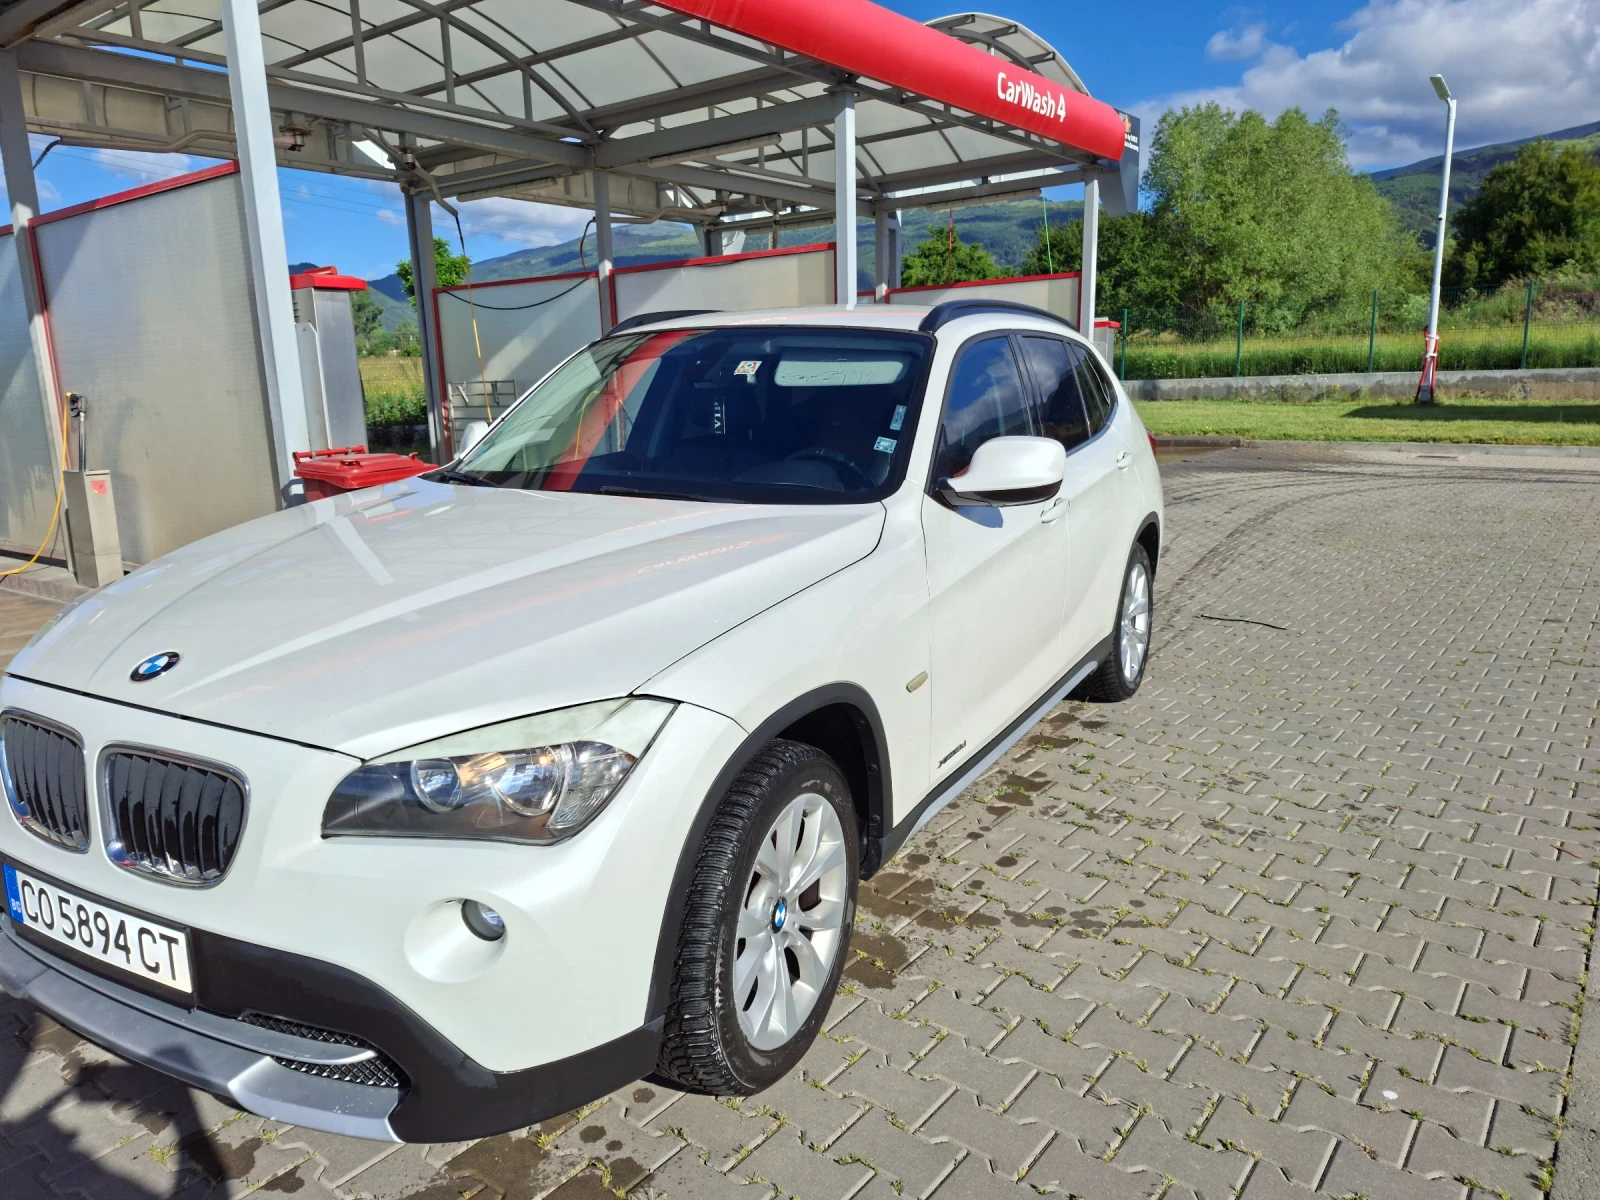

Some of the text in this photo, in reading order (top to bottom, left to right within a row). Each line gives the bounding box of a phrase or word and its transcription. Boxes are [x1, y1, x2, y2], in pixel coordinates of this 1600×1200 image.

[997, 72, 1066, 122] CarWash 4
[11, 898, 21, 913] BG
